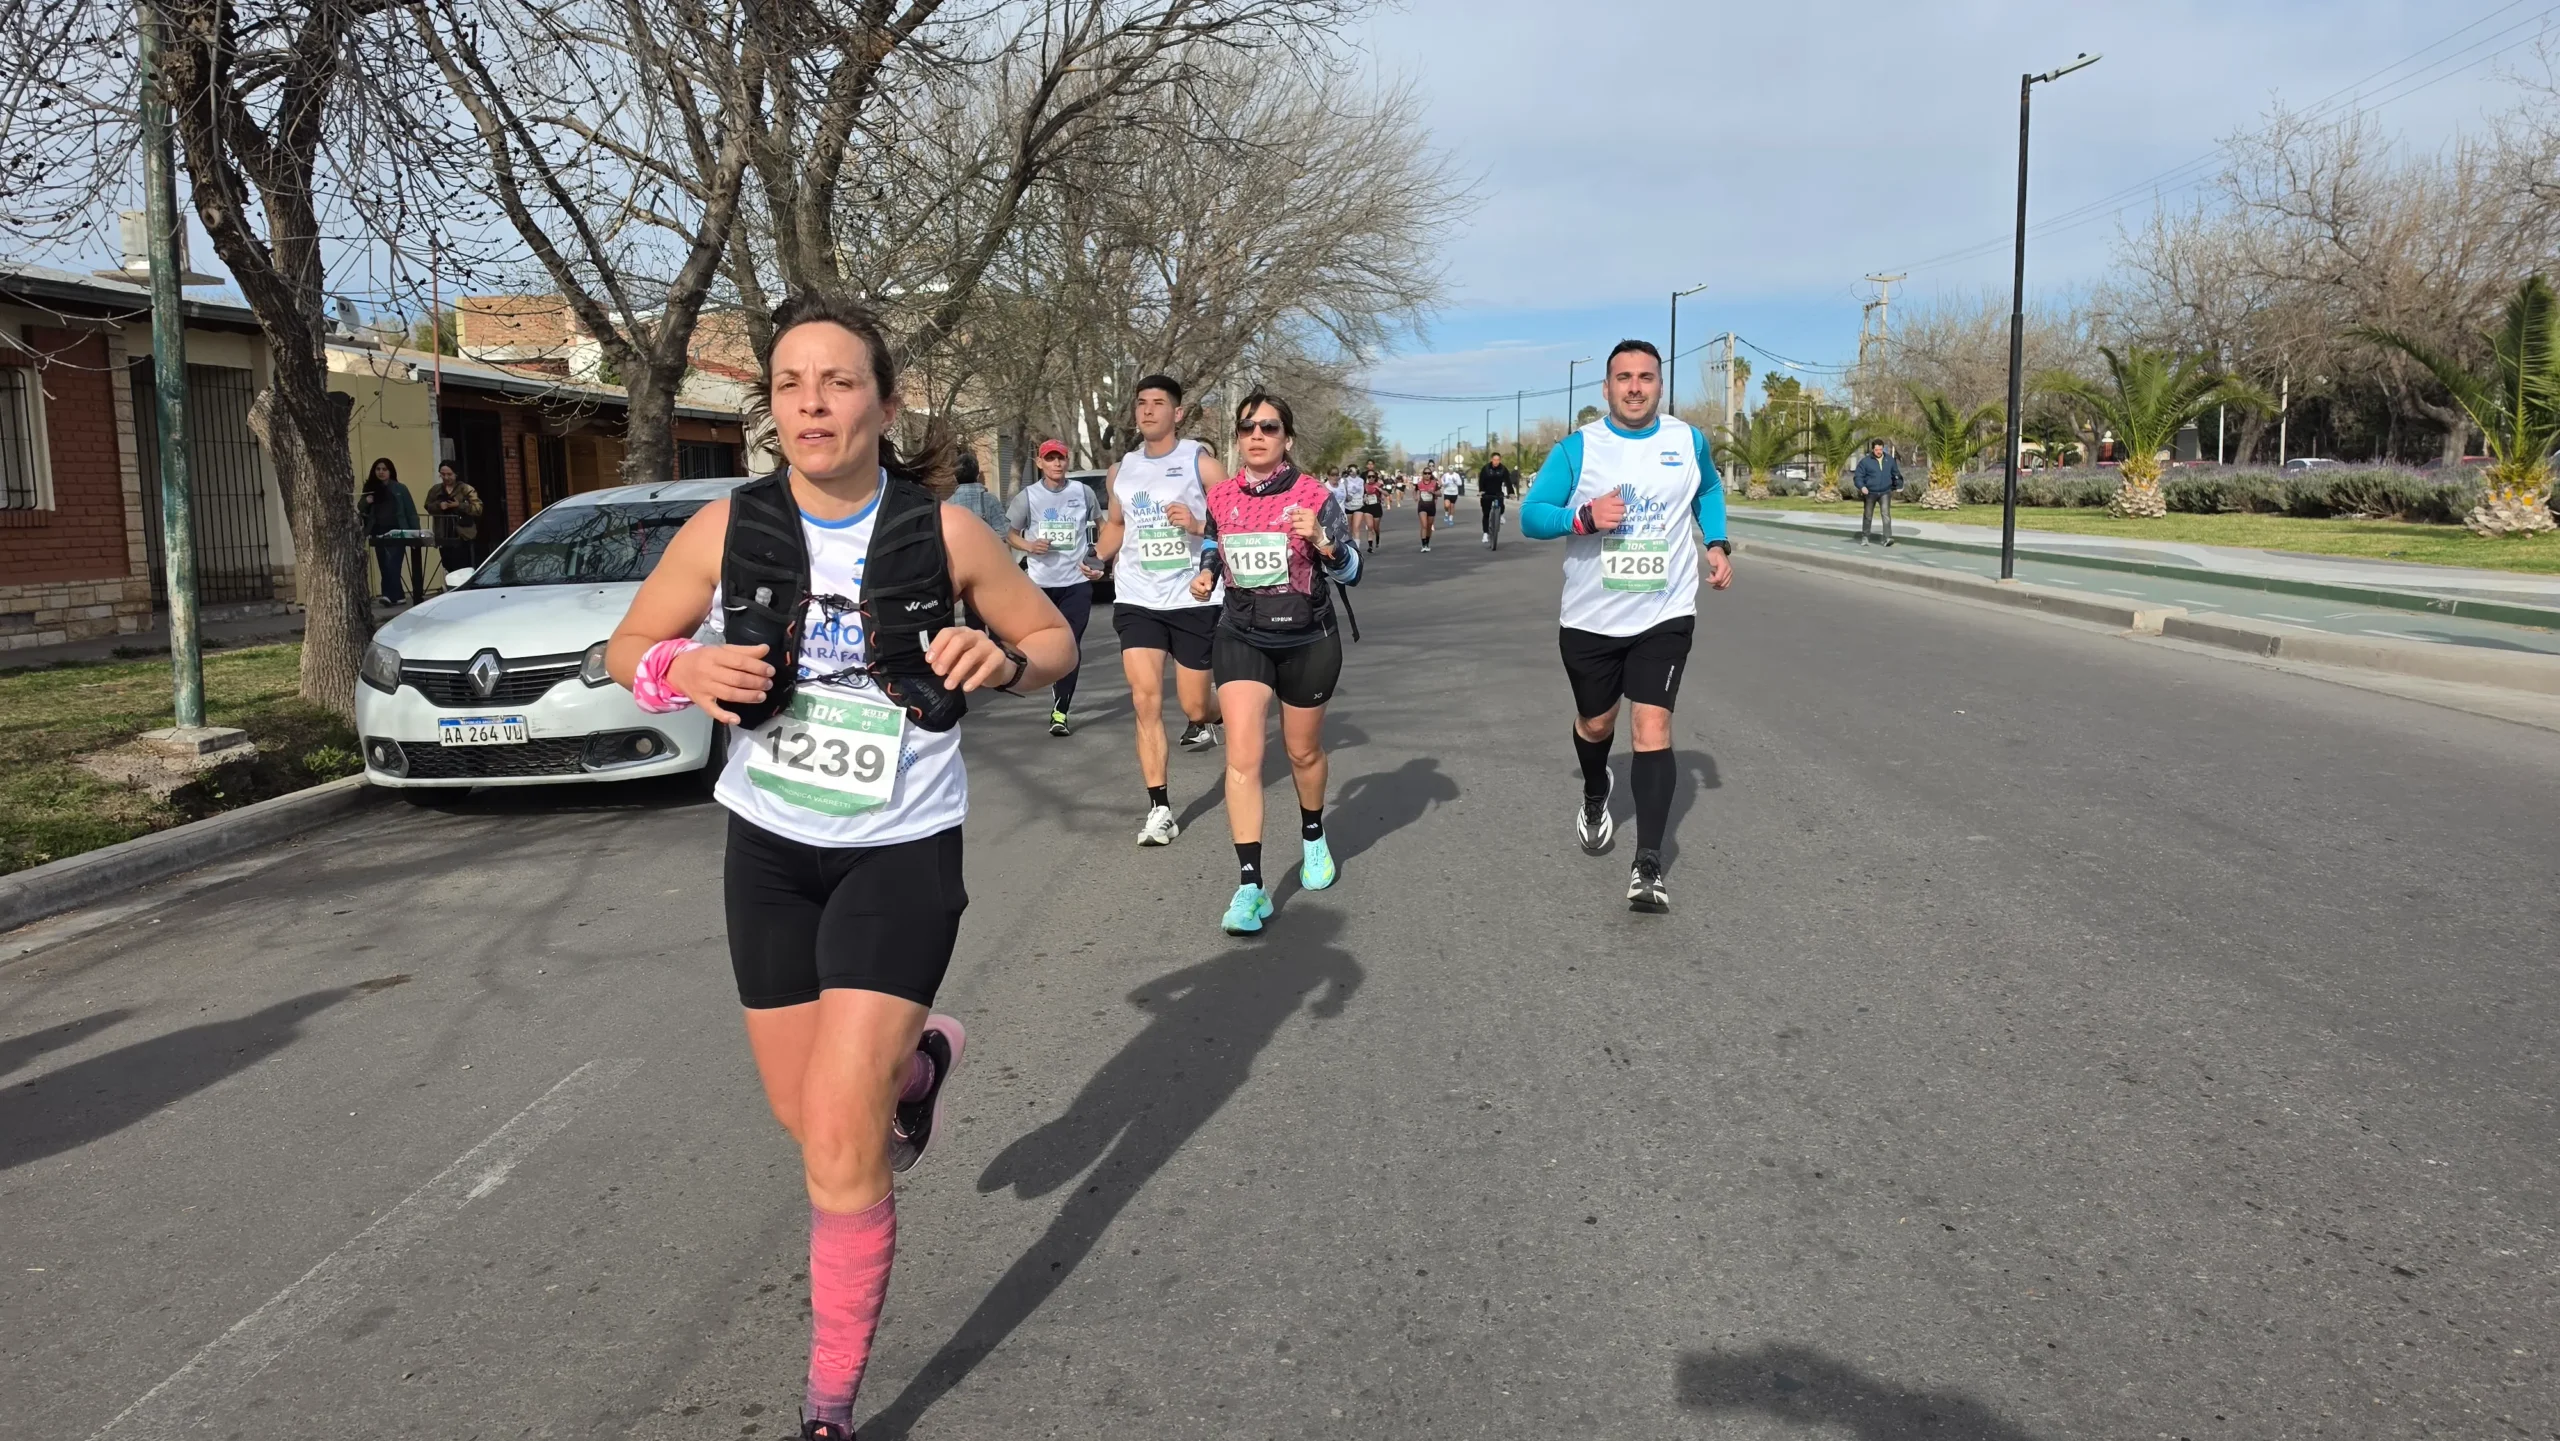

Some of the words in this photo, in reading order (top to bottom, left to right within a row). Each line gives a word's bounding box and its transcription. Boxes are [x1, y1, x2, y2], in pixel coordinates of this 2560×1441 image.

[1042, 531, 1073, 541] 1334
[1245, 537, 1262, 545] 10K
[1141, 541, 1186, 557] 1329
[1627, 542, 1646, 551] 10K
[1231, 551, 1282, 570] 1185
[1606, 556, 1665, 575] 1268
[806, 703, 848, 724] 10K
[444, 727, 464, 743] AA
[469, 725, 499, 742] 264
[766, 725, 886, 784] 1239
